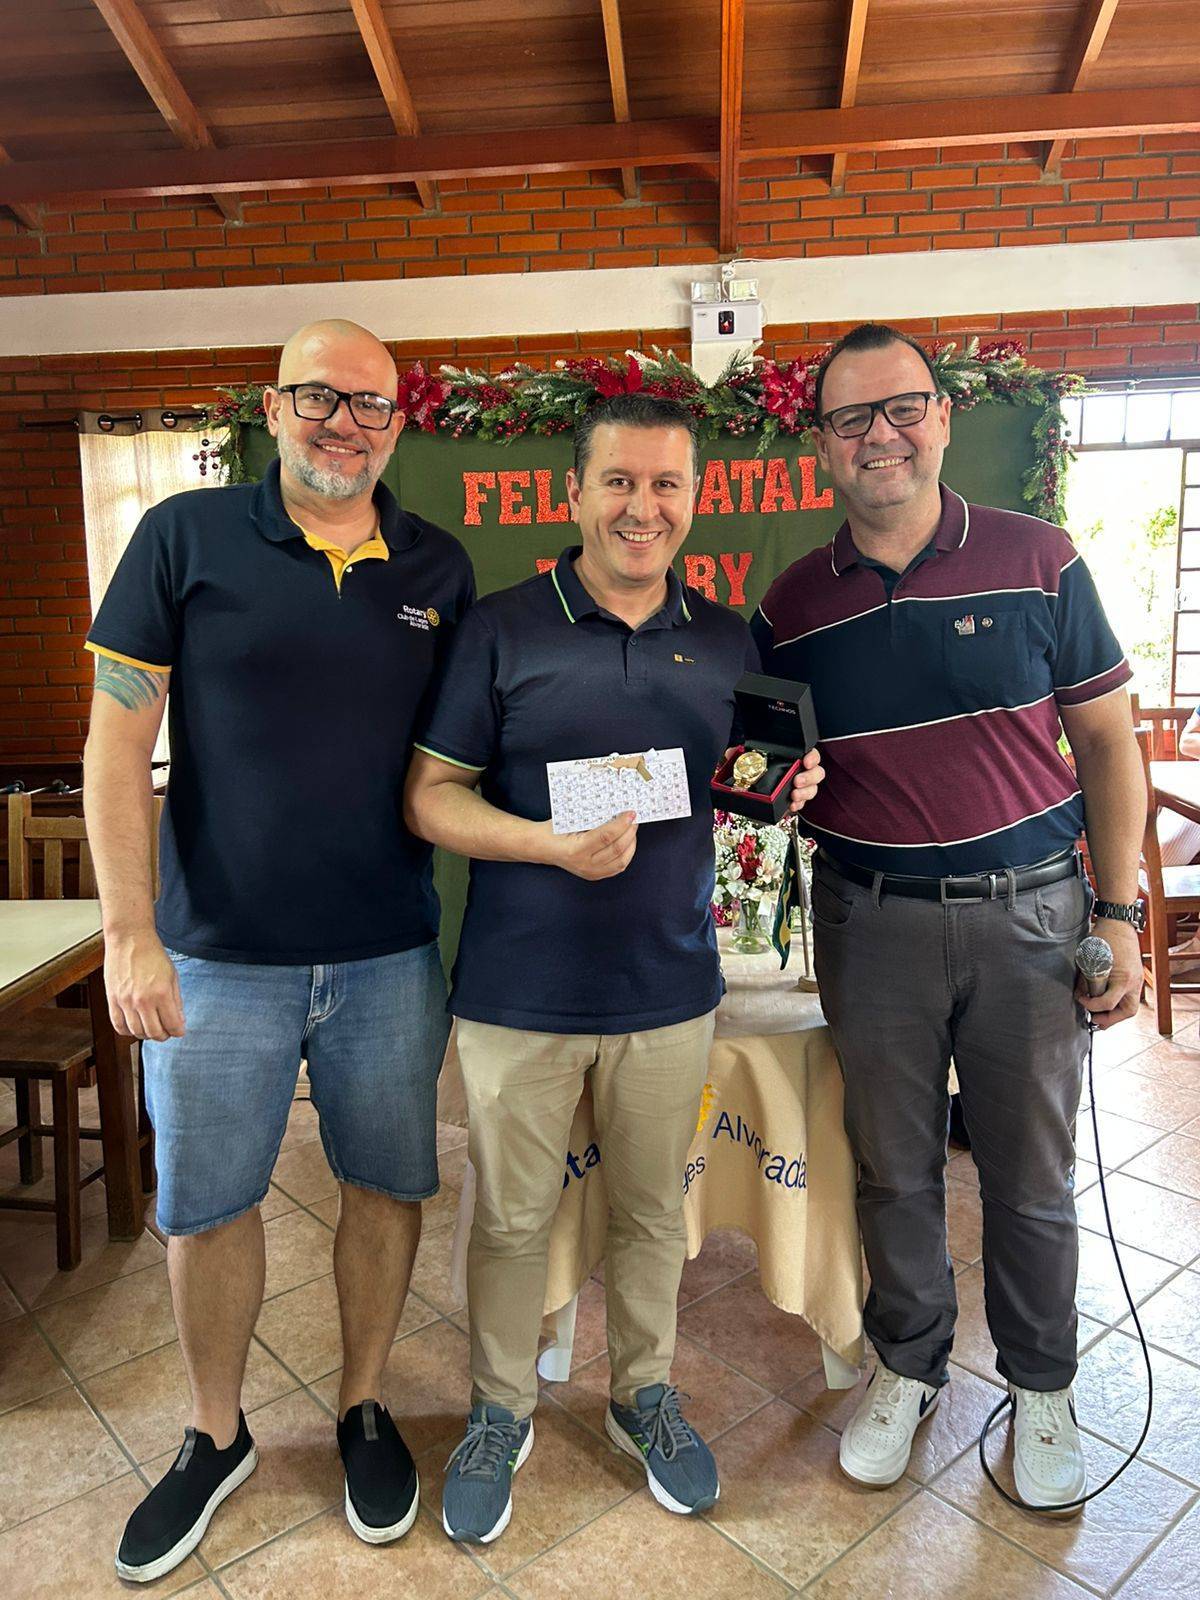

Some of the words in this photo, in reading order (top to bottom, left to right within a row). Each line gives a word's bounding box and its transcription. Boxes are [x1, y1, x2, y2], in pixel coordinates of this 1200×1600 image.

[462, 468, 568, 526] FEL
[693, 456, 834, 515] ATAL
[403, 605, 427, 619] Rotary
[768, 704, 797, 716] TECHNOS
[711, 1111, 807, 1189] Alvorada
